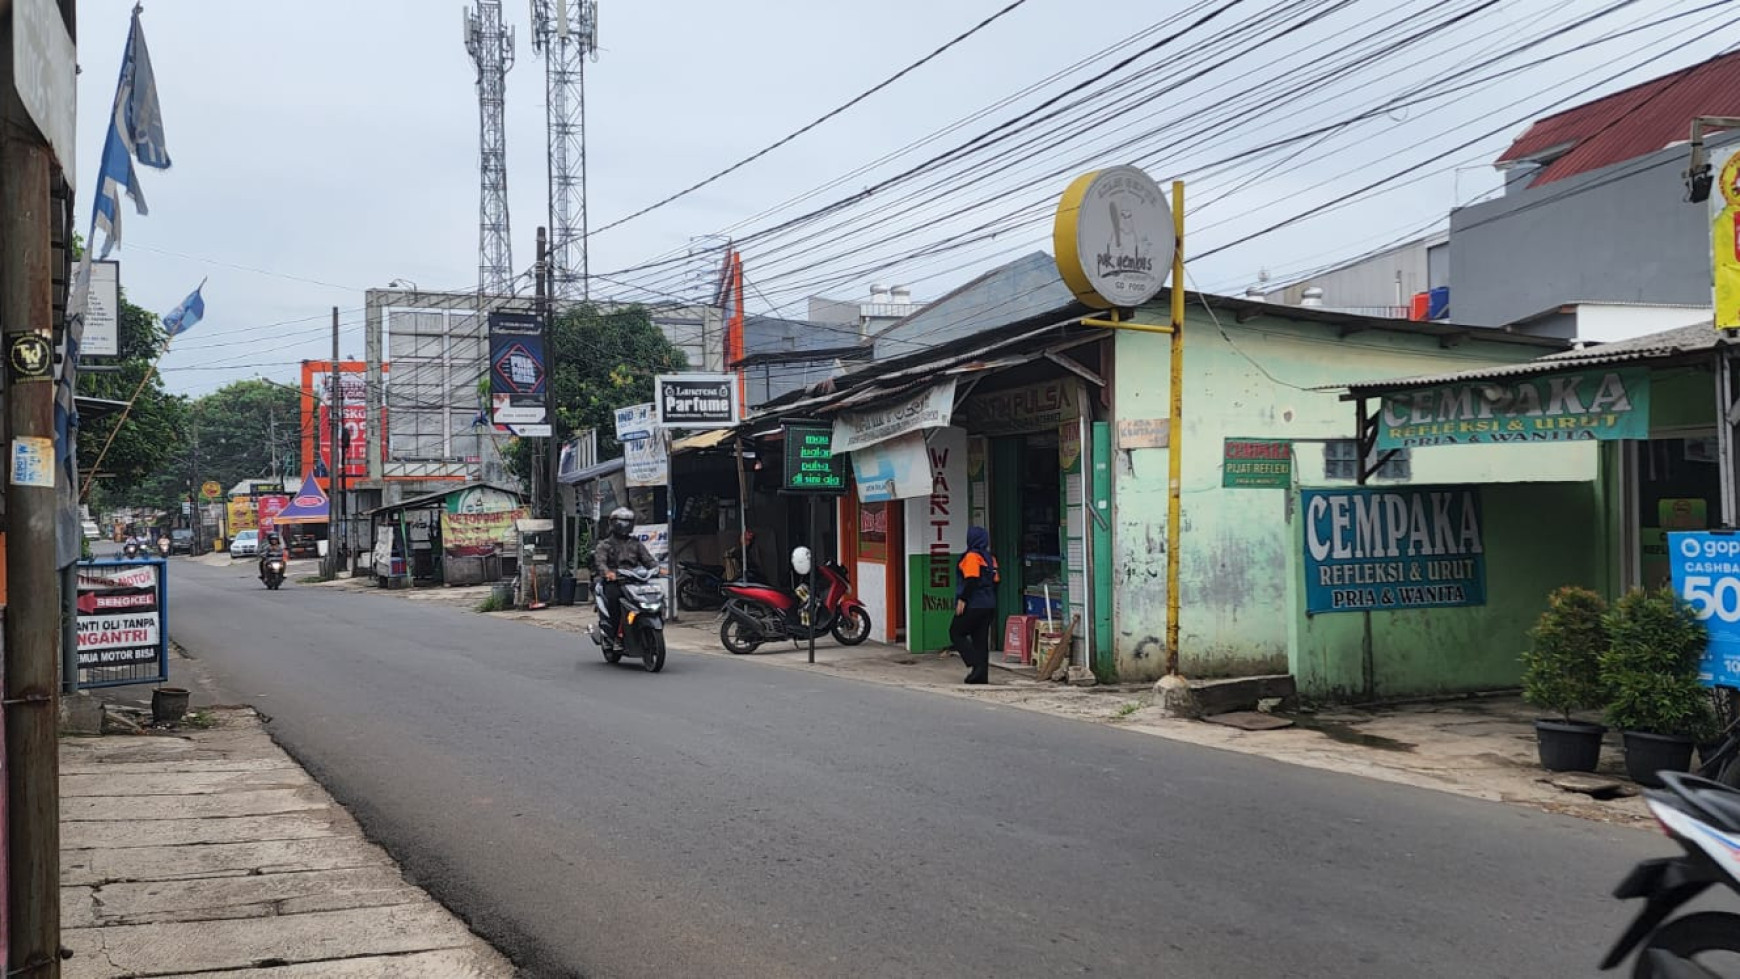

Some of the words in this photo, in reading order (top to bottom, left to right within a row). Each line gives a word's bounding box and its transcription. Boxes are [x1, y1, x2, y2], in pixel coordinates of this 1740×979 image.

[666, 396, 729, 412] Parfume
[1013, 384, 1071, 416] PULSA
[1384, 373, 1632, 427] CEMPAKA
[1389, 421, 1499, 439] REFLEKSI
[1507, 420, 1524, 431] &
[1534, 414, 1620, 429] URUT
[805, 436, 829, 444] mau
[1404, 433, 1458, 446] PRIA
[1468, 433, 1482, 443] &
[1490, 430, 1597, 442] WANITA
[1226, 464, 1250, 474] PIJAT
[930, 447, 950, 587] WARTEG
[1307, 492, 1482, 561] CEMPAKA
[1319, 561, 1404, 585] REFLEKSI
[1409, 561, 1422, 581] &
[1428, 559, 1474, 580] URUT
[97, 594, 154, 606] BENGKEL
[1332, 588, 1376, 608] PRIA
[1380, 587, 1394, 604] &
[1399, 584, 1466, 604] WANITA
[1683, 576, 1740, 622] 50
[102, 620, 120, 630] OLI
[123, 618, 155, 629] TANPA
[76, 629, 148, 645] NGANTRI
[101, 650, 133, 662] MOTOR
[134, 648, 155, 659] BISA
